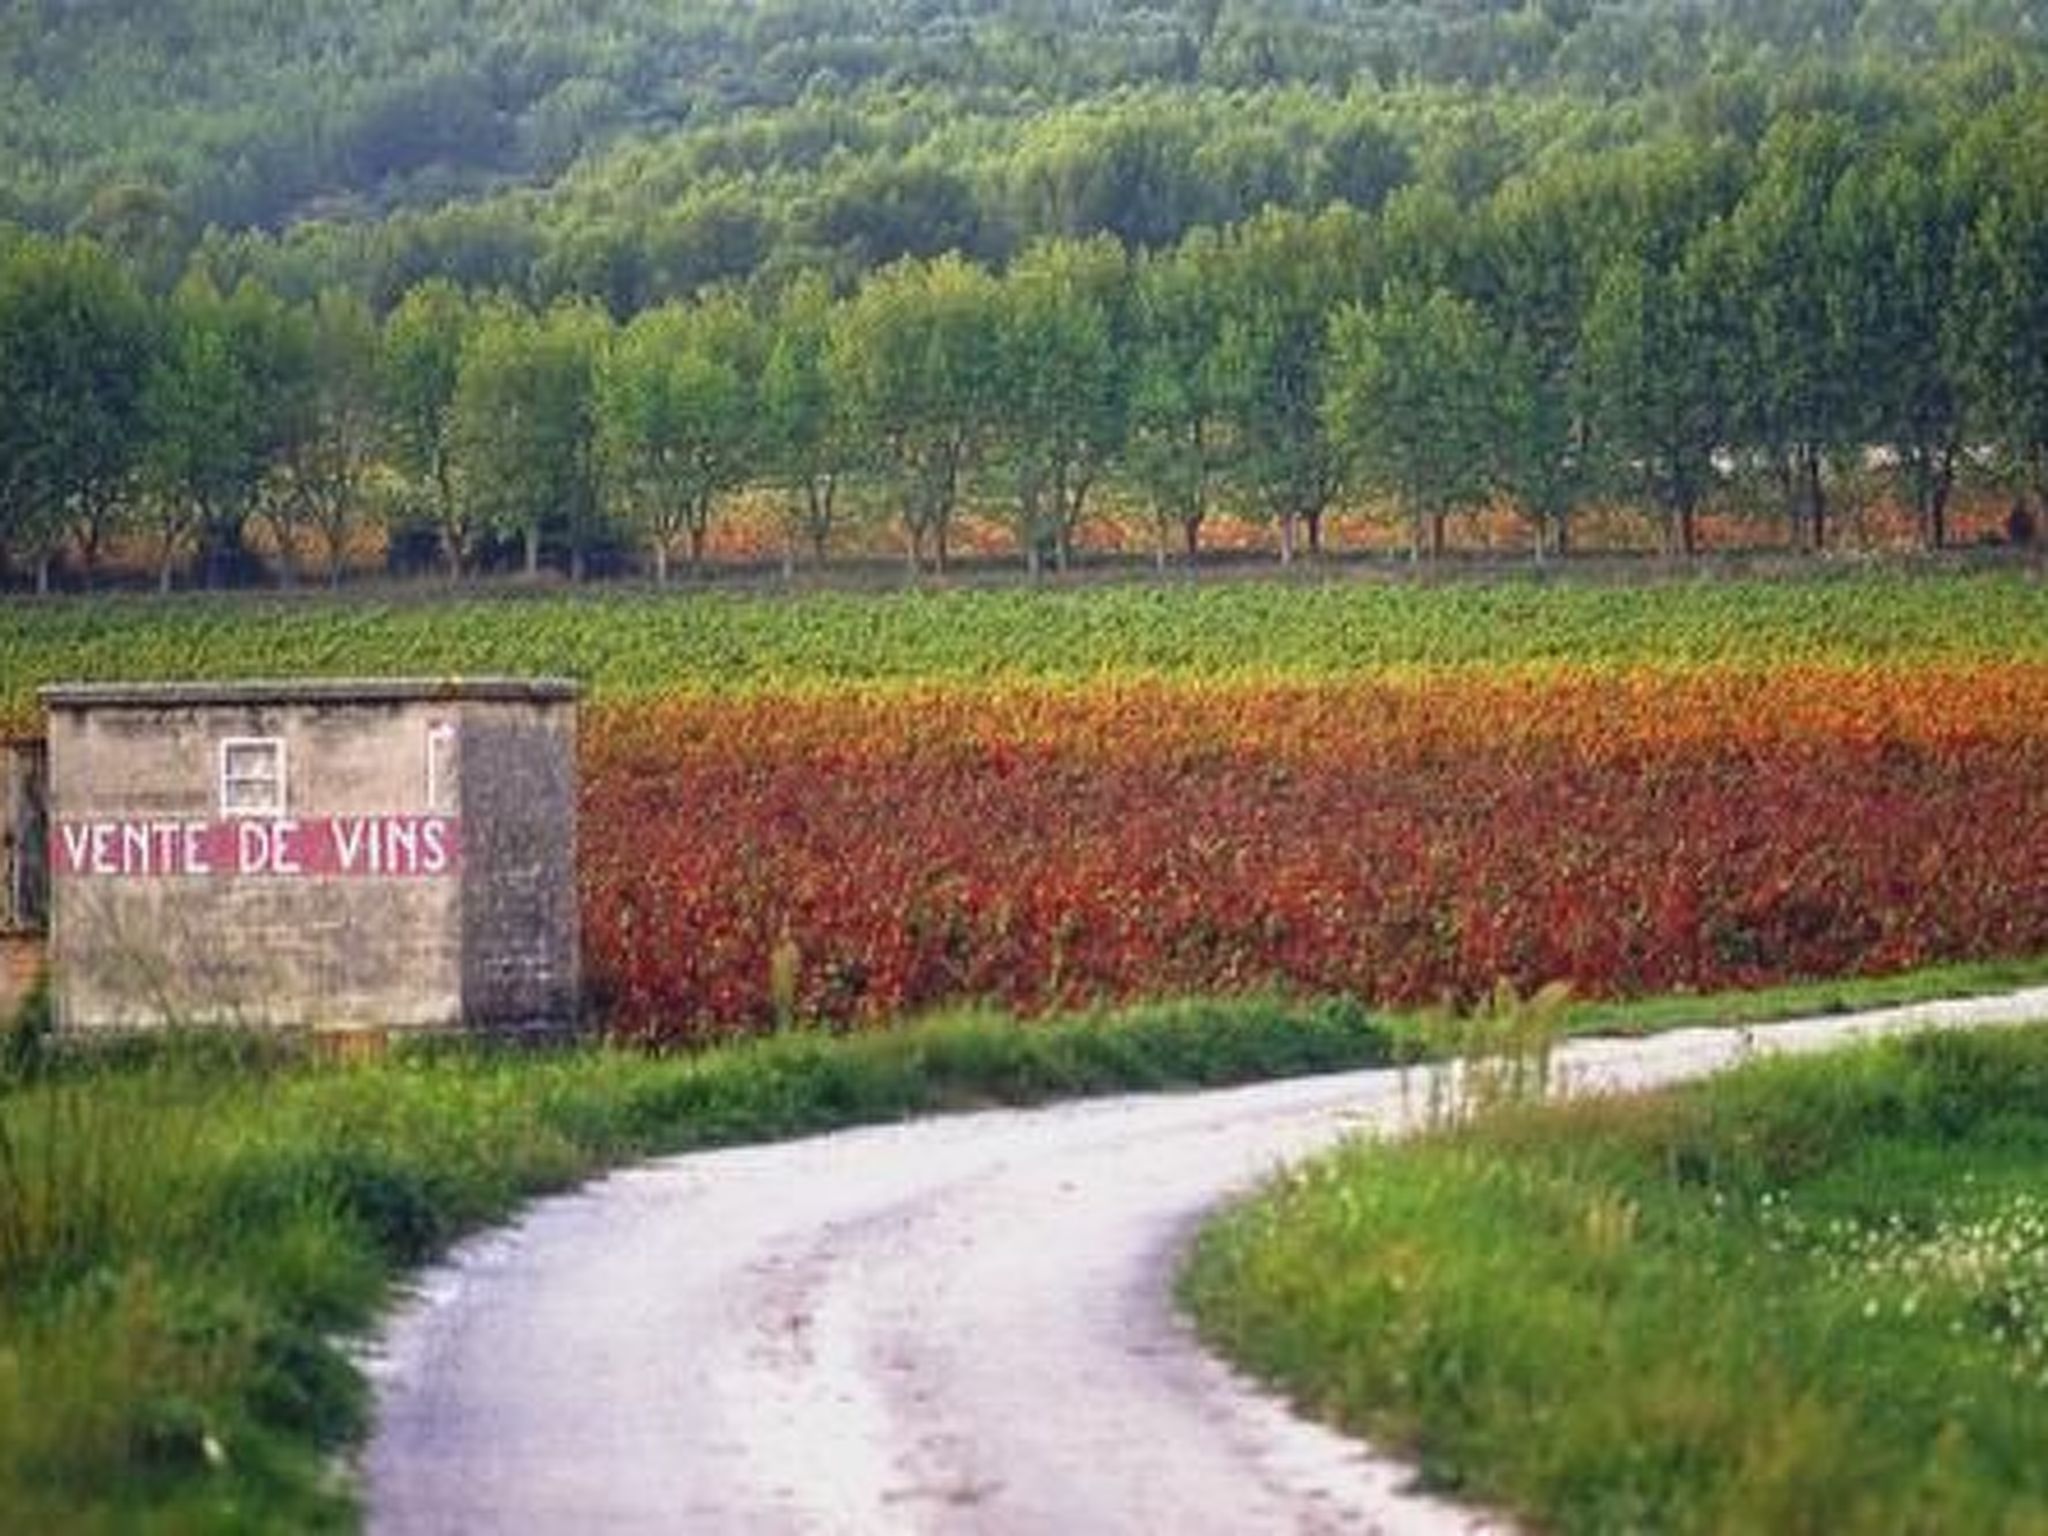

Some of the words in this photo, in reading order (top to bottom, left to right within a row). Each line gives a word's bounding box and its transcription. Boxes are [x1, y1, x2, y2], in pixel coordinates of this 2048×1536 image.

[63, 823, 210, 874] VENTE
[238, 821, 300, 873] DE
[332, 819, 447, 872] VINS
